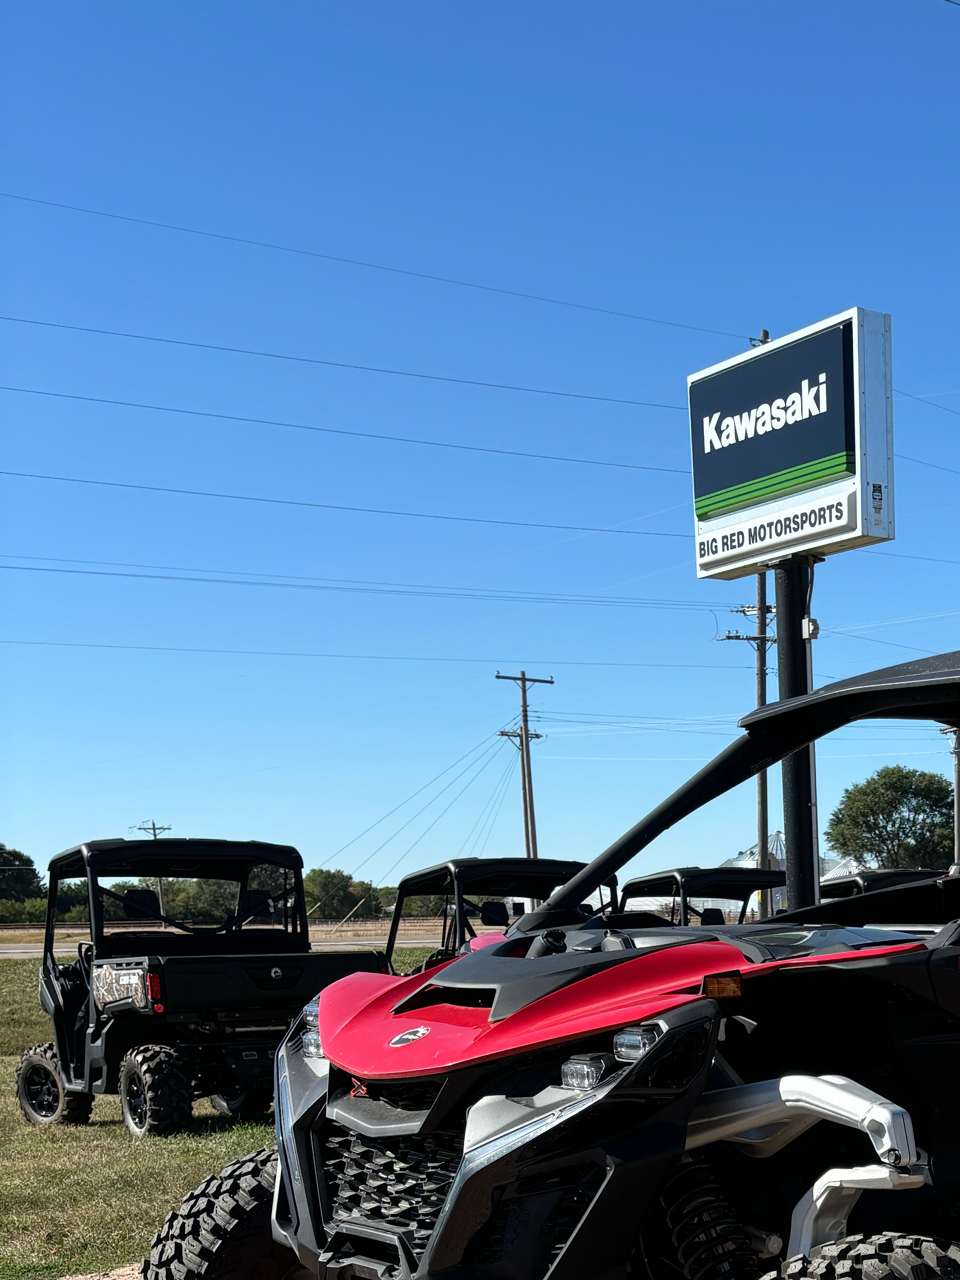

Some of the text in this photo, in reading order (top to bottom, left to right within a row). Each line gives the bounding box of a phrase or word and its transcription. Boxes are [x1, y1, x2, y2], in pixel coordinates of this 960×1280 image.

[703, 373, 827, 453] Kawasaki
[698, 502, 844, 558] BIG RED MOTORSPORTS
